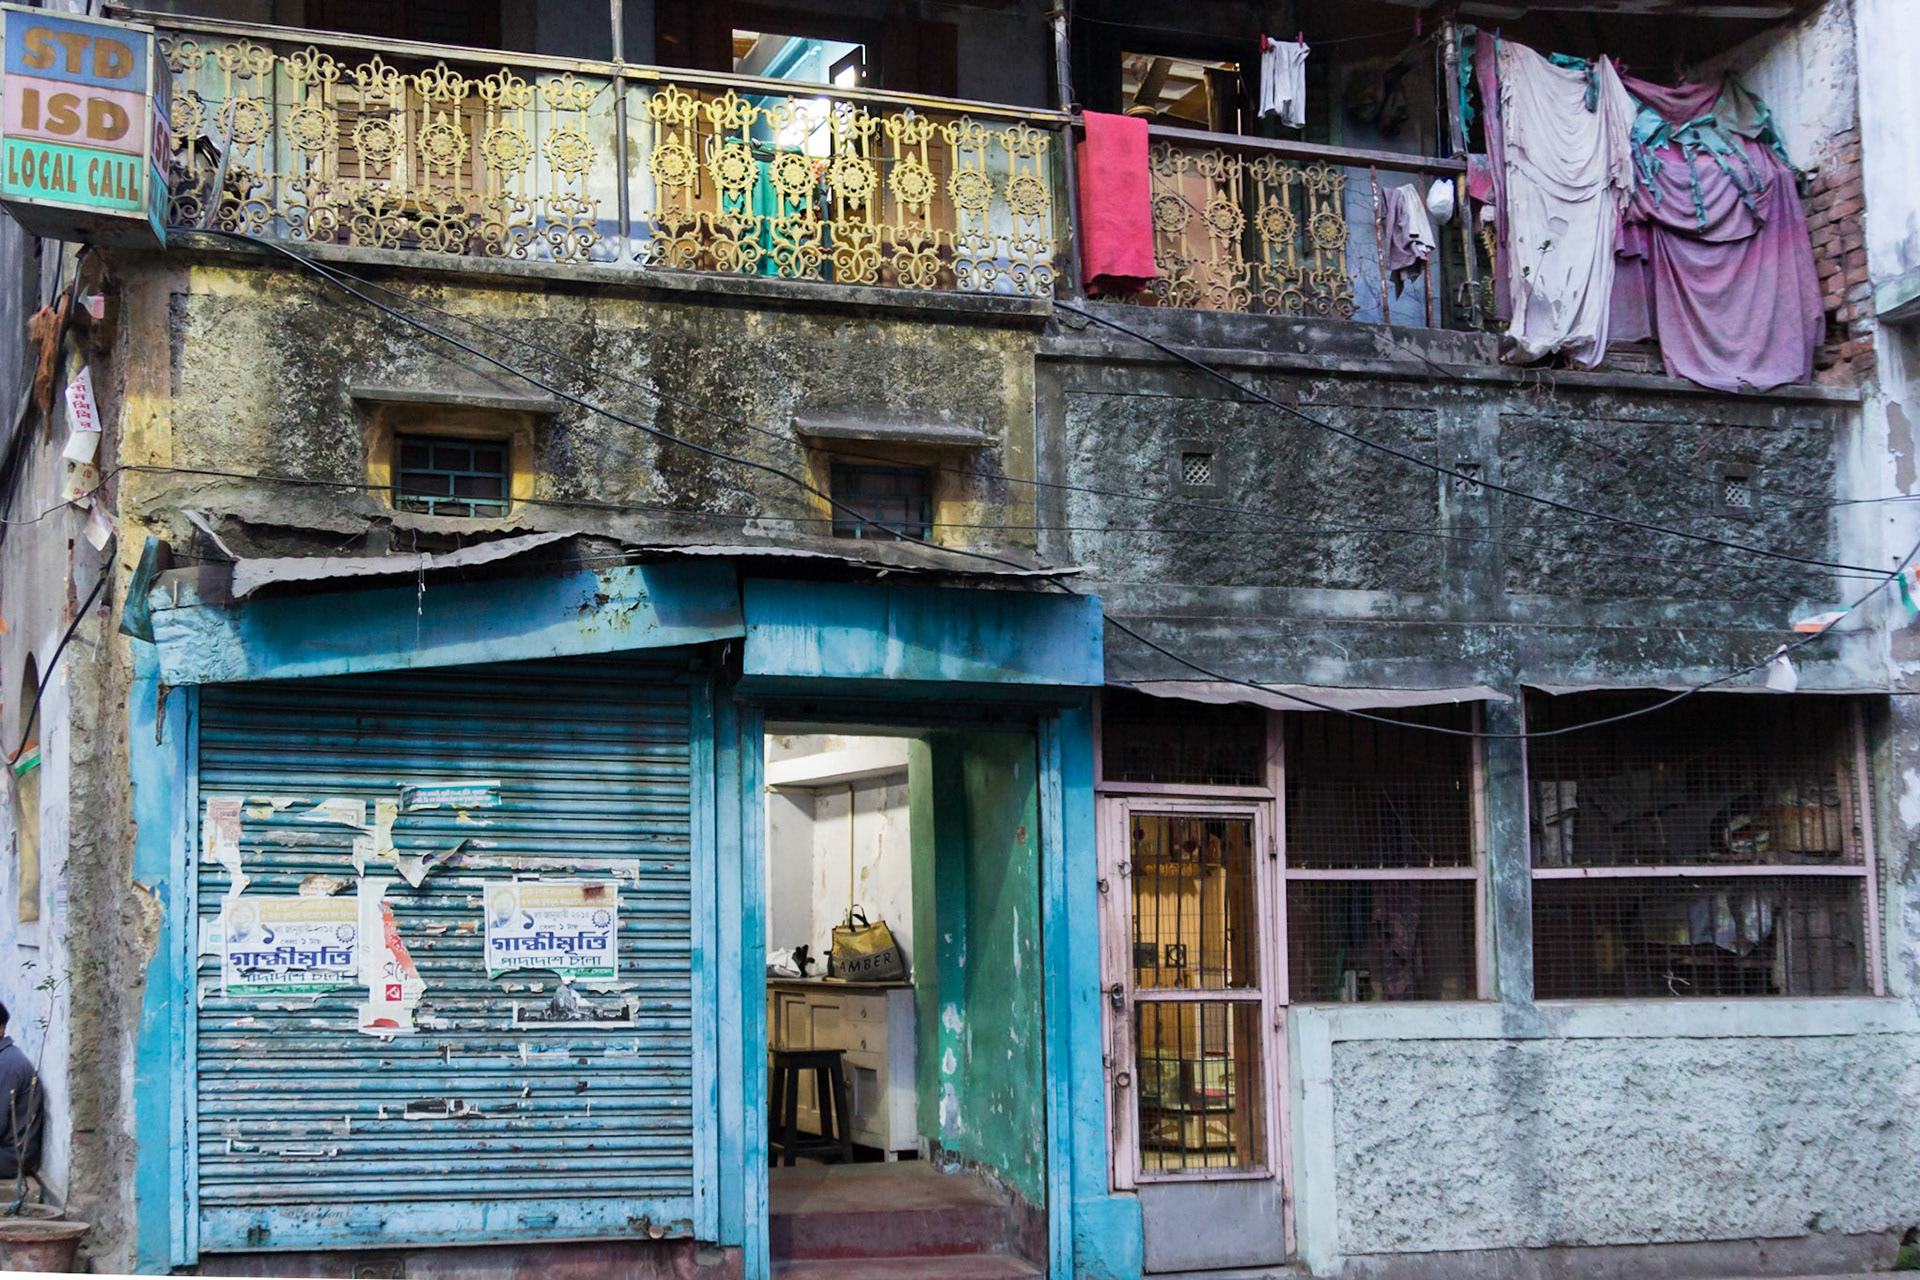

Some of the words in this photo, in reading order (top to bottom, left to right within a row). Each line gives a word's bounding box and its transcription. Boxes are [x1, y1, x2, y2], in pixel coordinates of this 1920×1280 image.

[22, 27, 134, 79] STD
[21, 88, 130, 141] ISD
[152, 112, 170, 173] ISD
[8, 146, 77, 193] LOCAL
[88, 157, 139, 201] CALL
[839, 952, 892, 973] AMBER
